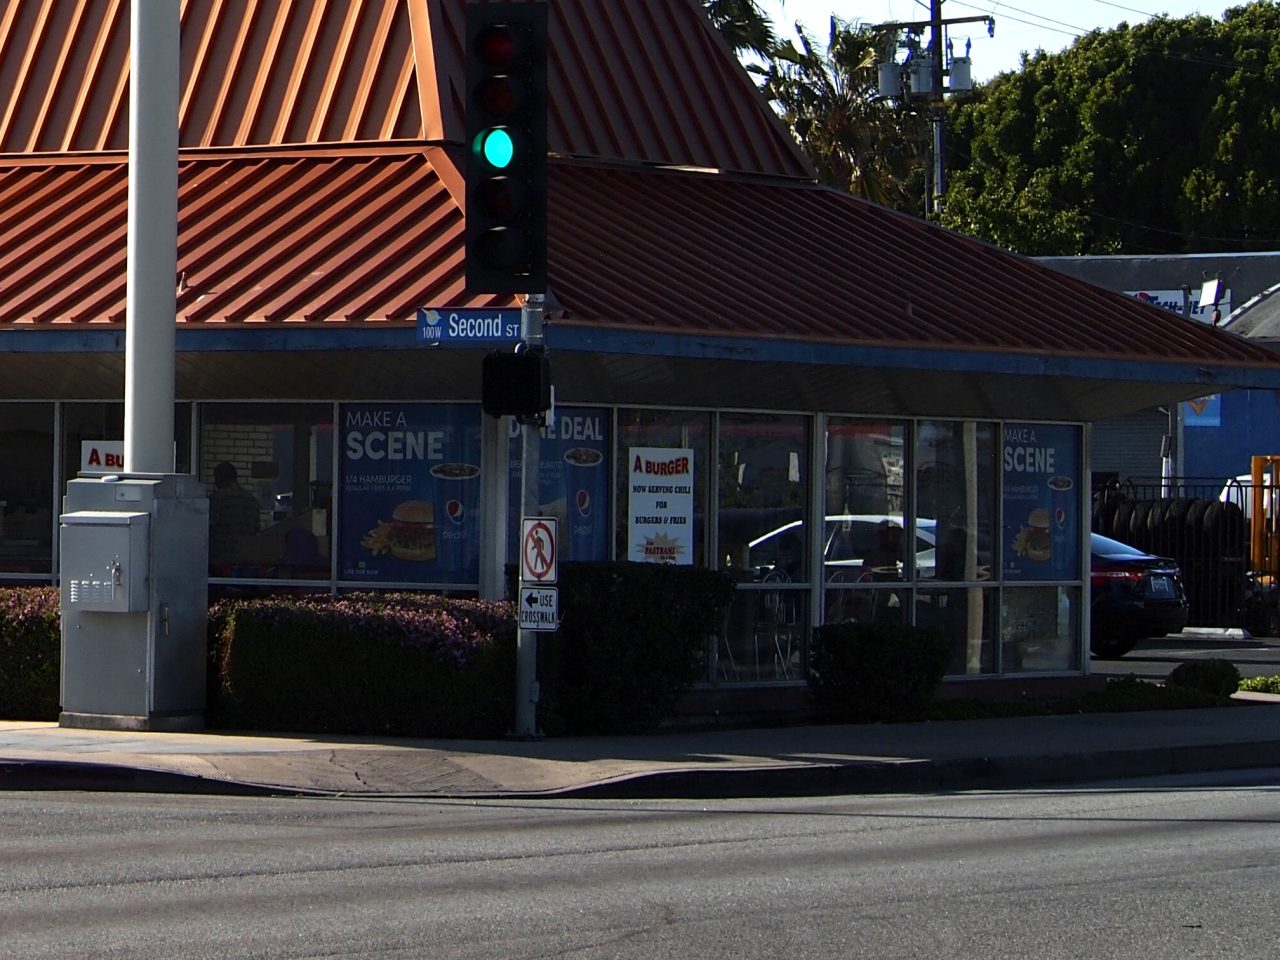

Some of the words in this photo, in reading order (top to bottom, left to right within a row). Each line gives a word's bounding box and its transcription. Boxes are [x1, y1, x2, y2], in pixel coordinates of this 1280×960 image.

[449, 313, 502, 337] Second
[506, 324, 520, 337] ST
[346, 411, 392, 427] MAKE
[395, 411, 407, 427] A
[509, 415, 557, 439] DE
[561, 416, 604, 441] DEAL
[1004, 429, 1028, 443] MAKE
[1030, 430, 1037, 443] A
[346, 431, 444, 460] SCENE
[88, 447, 101, 465] A
[1004, 446, 1056, 473] SCENE
[633, 455, 643, 473] A
[645, 457, 689, 476] BURGER
[359, 474, 413, 485] HAMBURGER
[632, 485, 647, 493] NOW
[647, 486, 674, 494] SERVING
[674, 486, 691, 494] CHILI
[655, 501, 667, 509] FOR
[635, 516, 662, 524] BURGERS
[669, 516, 686, 525] FRIES
[540, 595, 553, 607] USE
[521, 610, 556, 624] CROSSWALK
